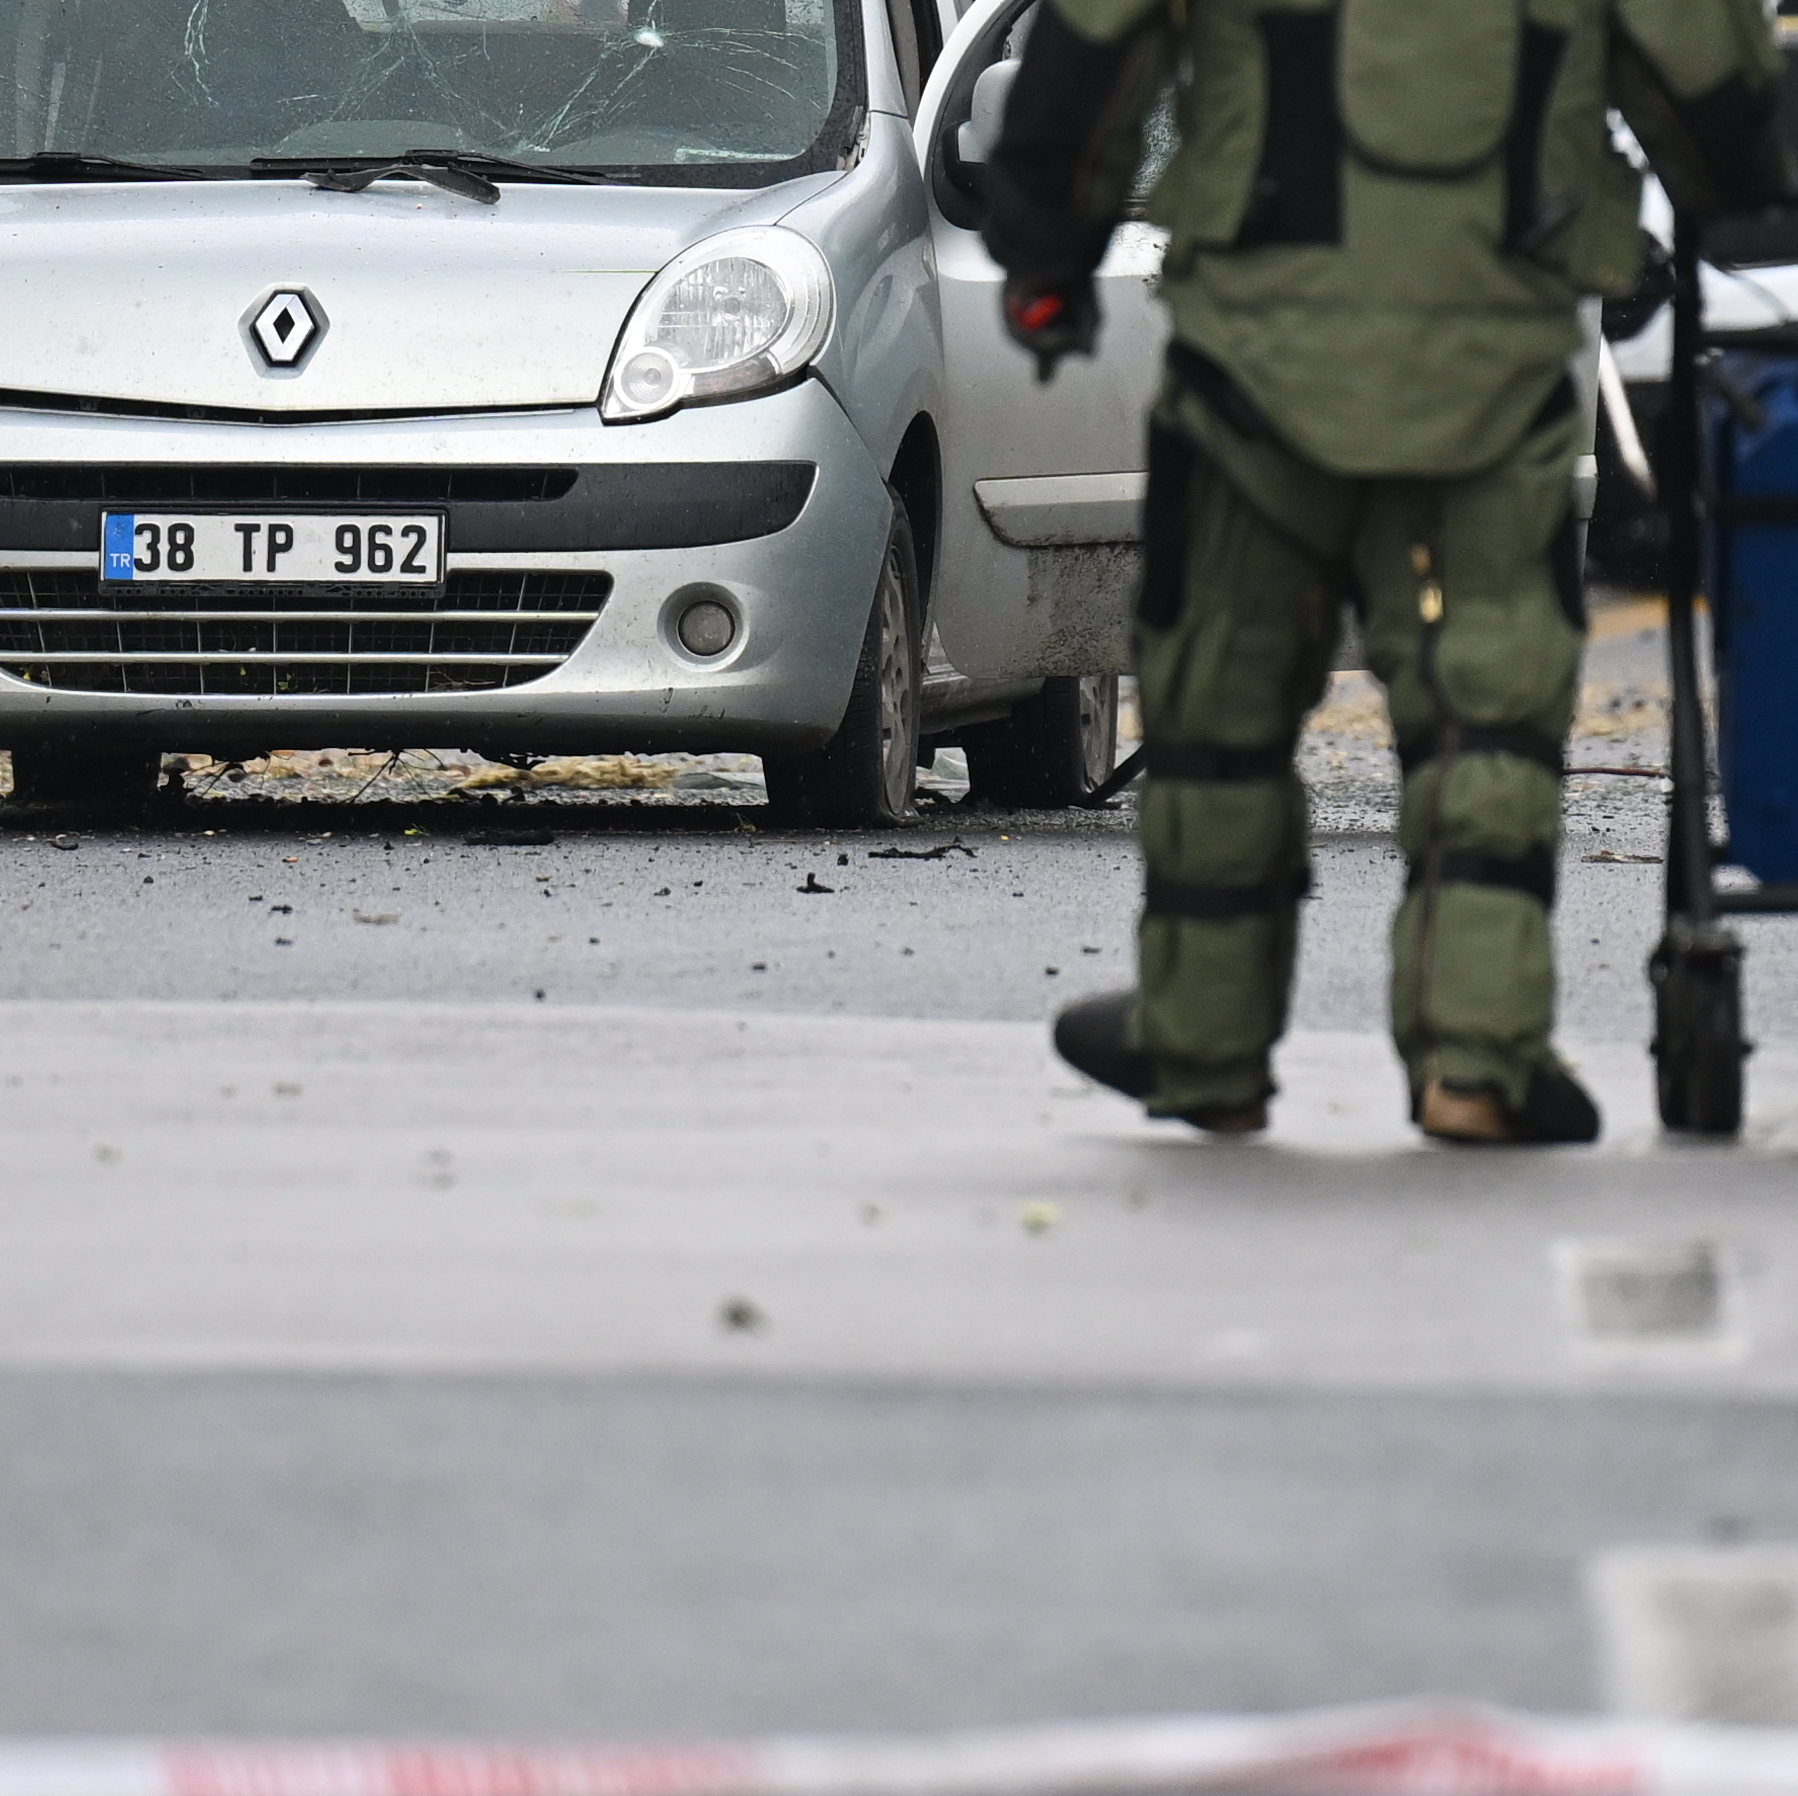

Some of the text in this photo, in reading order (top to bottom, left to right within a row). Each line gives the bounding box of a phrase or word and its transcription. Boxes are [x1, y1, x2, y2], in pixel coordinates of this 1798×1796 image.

[109, 553, 131, 568] TR
[133, 523, 427, 574] 38 TP 962
